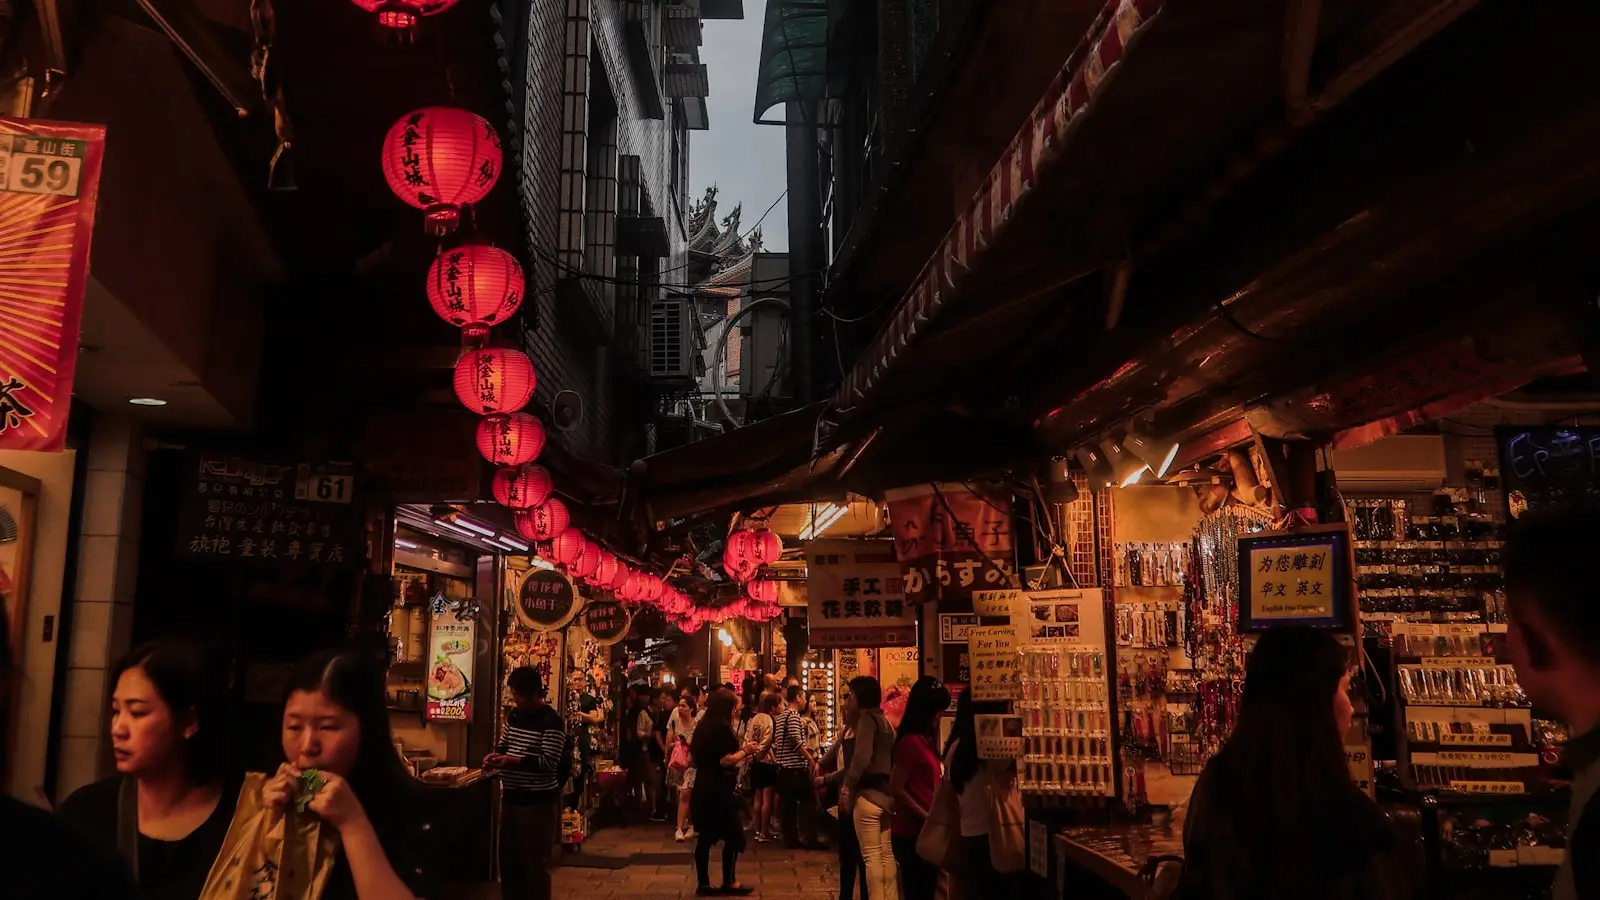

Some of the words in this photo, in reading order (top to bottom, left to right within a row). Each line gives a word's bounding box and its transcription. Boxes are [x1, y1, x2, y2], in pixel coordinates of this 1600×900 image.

[20, 157, 71, 191] 59
[479, 353, 499, 404] 黃金山城
[499, 420, 515, 458] 金山城
[317, 476, 346, 499] 61
[188, 532, 232, 555] 旗袍
[284, 538, 347, 566] 專賣店
[1258, 551, 1327, 573] 为您雕刻
[842, 577, 882, 597] 手工
[903, 558, 1013, 595] からすみ
[1260, 580, 1288, 599] 华文
[1295, 580, 1324, 597] 英文
[970, 629, 987, 637] Free
[987, 627, 1016, 637] Carving
[977, 640, 993, 649] For
[995, 639, 1010, 648] You
[975, 673, 993, 684] 中文
